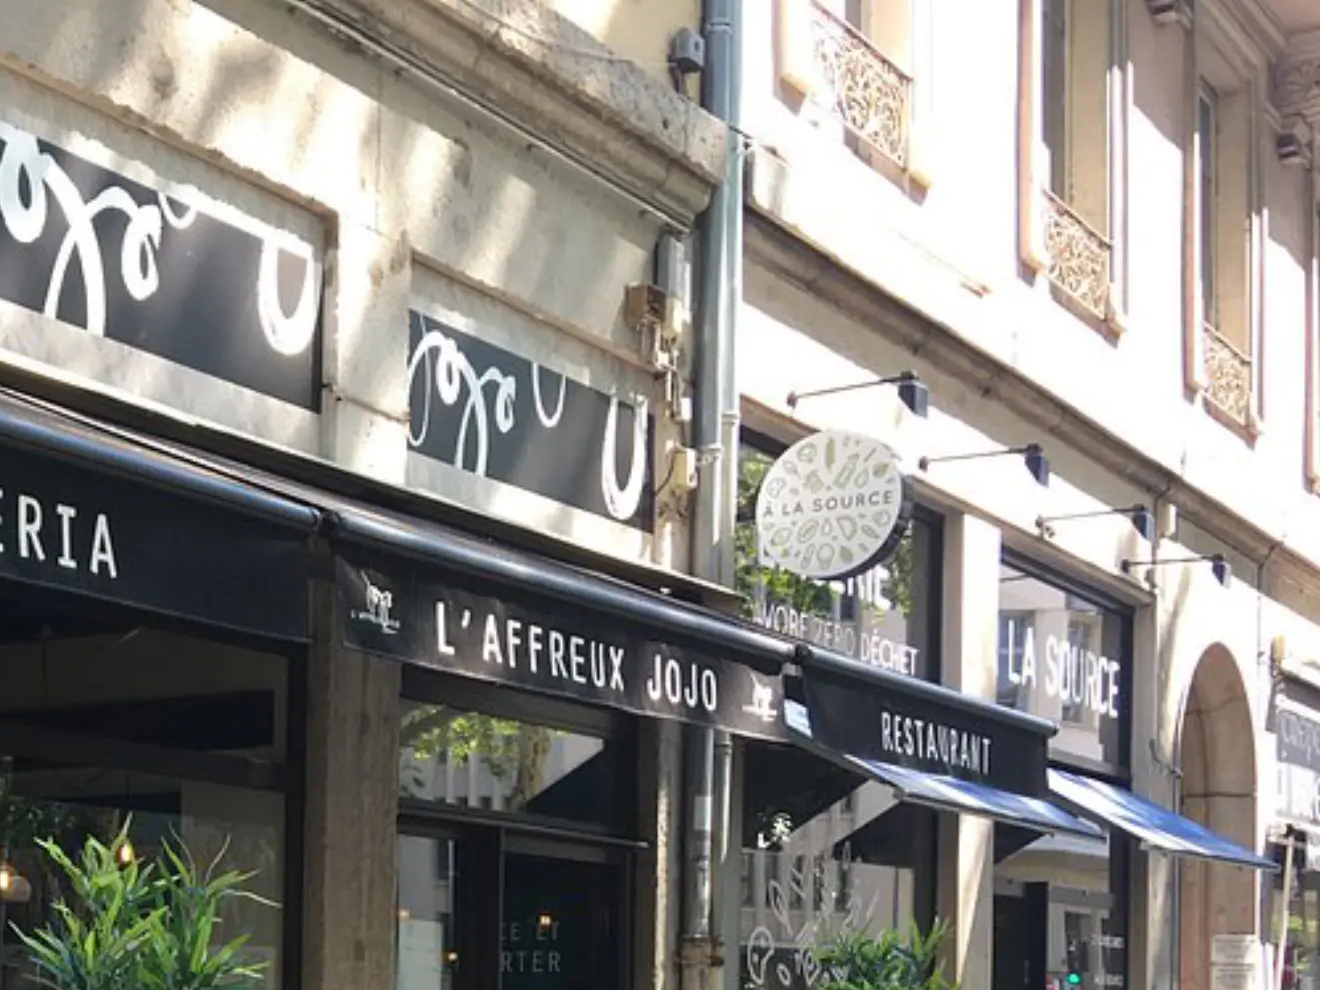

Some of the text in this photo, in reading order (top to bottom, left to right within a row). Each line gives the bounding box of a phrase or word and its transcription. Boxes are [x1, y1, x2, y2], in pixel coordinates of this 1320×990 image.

[781, 501, 804, 516] LA
[812, 490, 893, 513] SOURCE
[435, 601, 718, 711] L'AFFREUX JOJO
[1008, 619, 1121, 718] LA SOURCE
[881, 711, 991, 776] RESTAURANT
